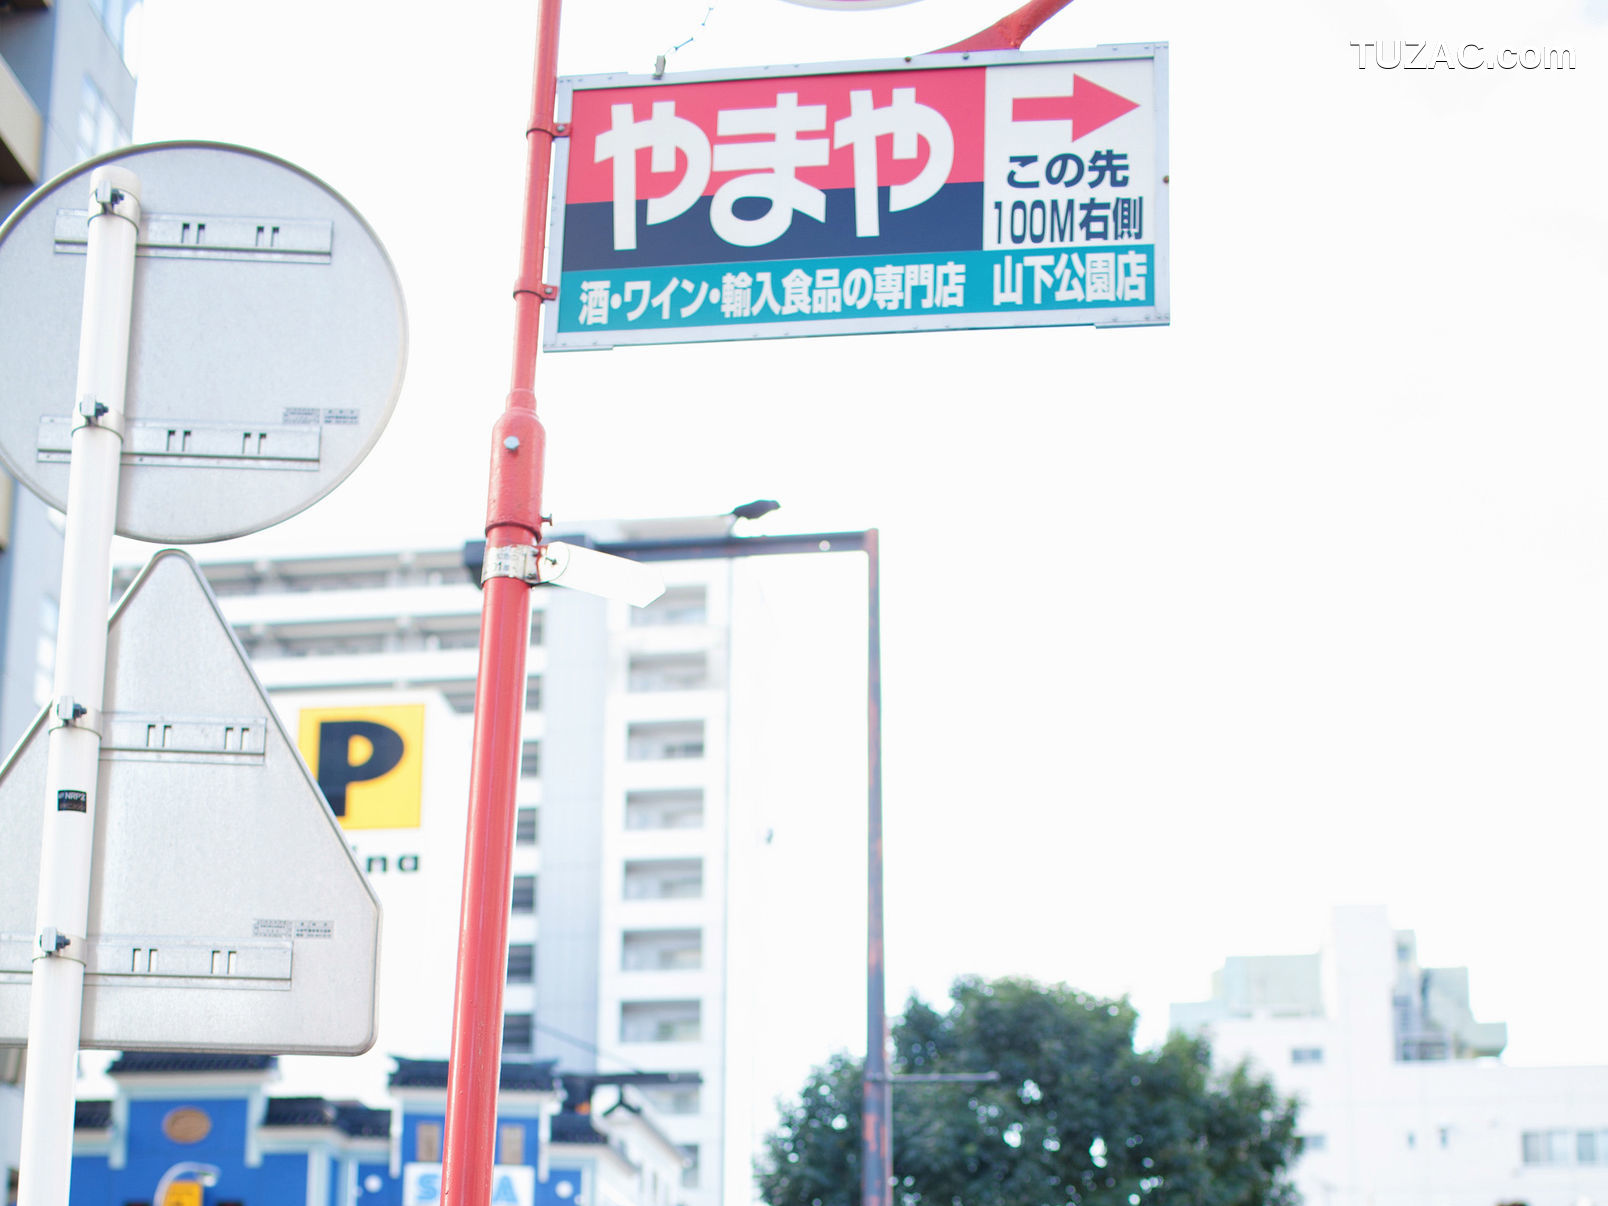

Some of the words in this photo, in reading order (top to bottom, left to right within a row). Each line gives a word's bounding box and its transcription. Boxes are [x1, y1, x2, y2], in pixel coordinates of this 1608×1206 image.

[594, 86, 955, 251] やまや
[1006, 149, 1130, 189] この先
[994, 196, 1144, 245] 100M右側
[578, 262, 967, 326] 酒・ワイン・輸入食品の専門店
[993, 251, 1148, 306] 山下公園店
[317, 720, 405, 817] P
[352, 845, 420, 873] na
[417, 1173, 518, 1204] SA
